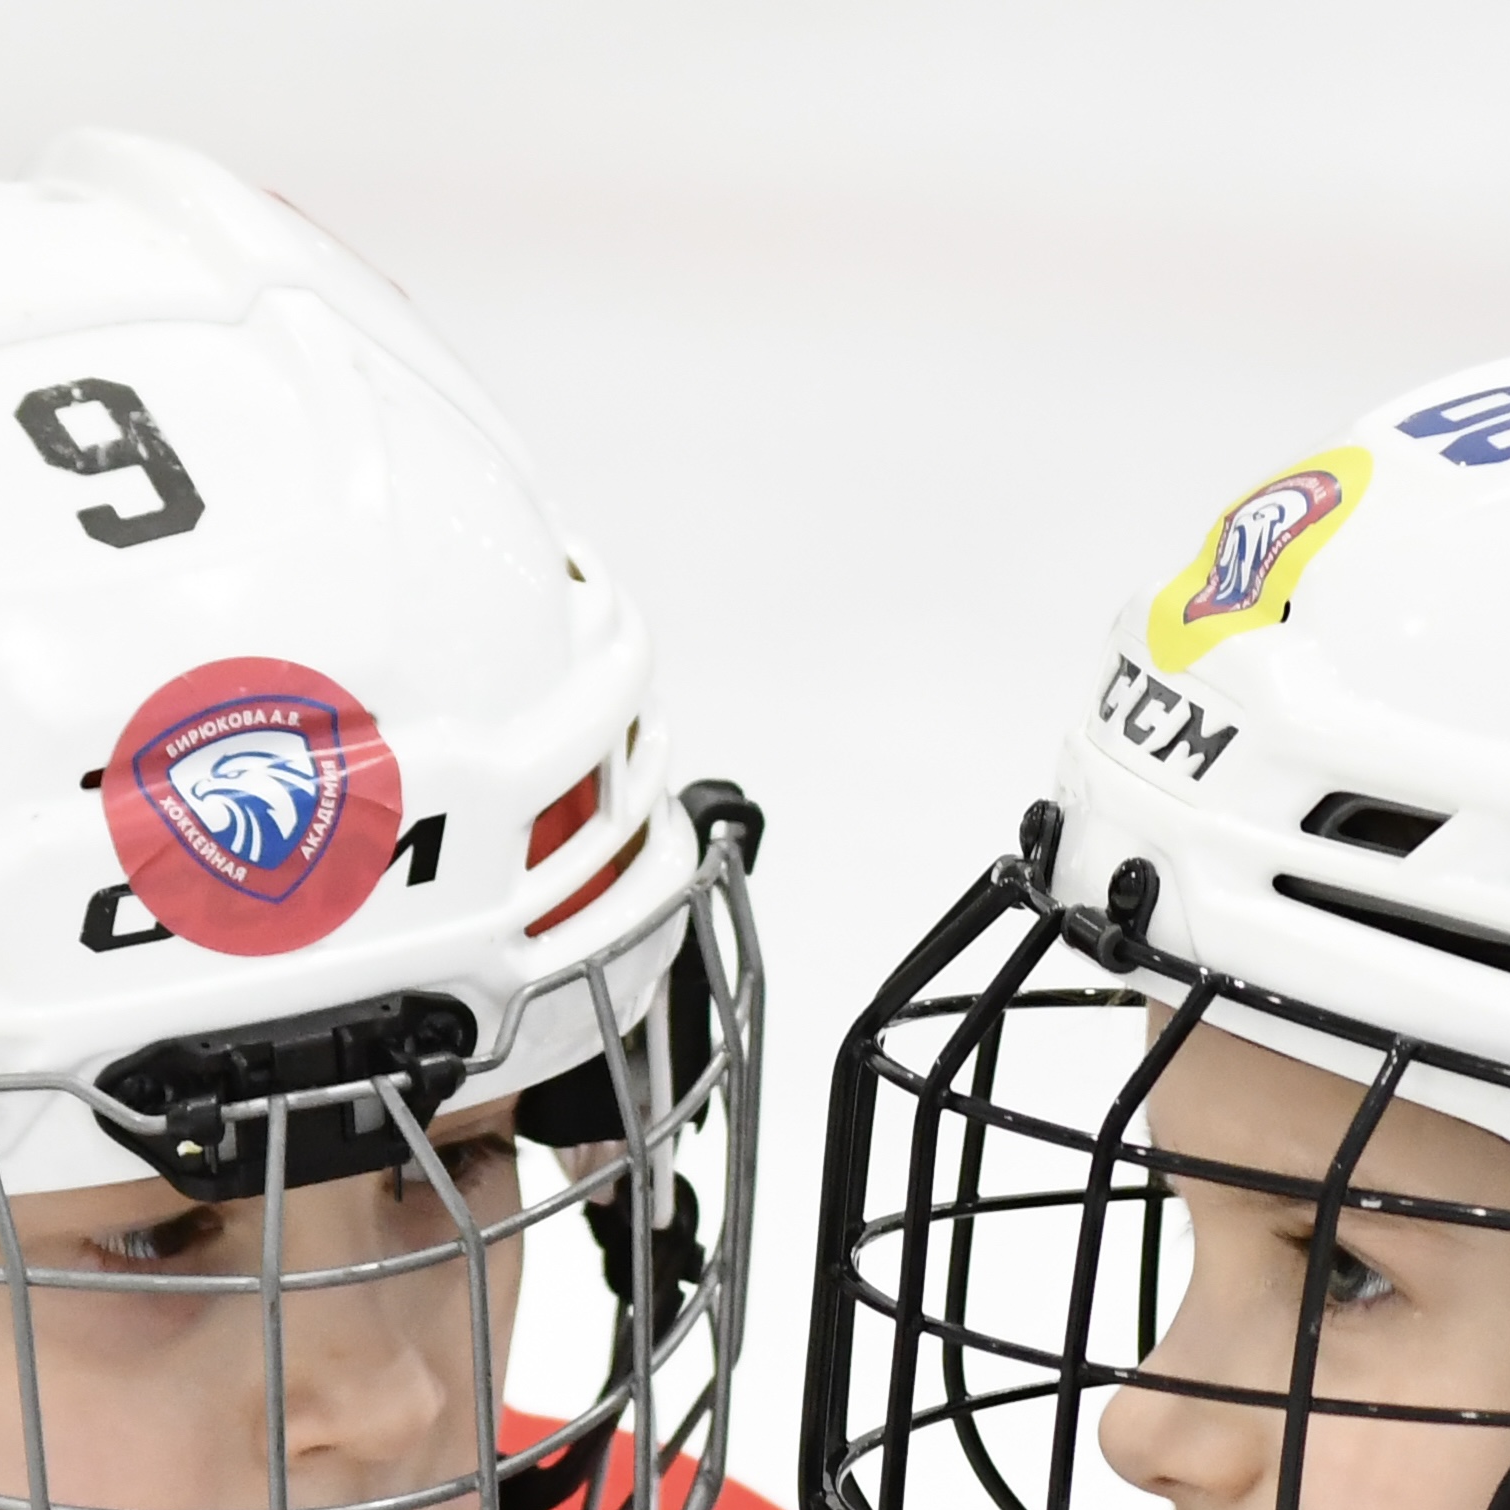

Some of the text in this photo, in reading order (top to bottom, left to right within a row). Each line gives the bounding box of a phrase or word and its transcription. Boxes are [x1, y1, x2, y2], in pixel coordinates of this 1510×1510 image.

[13, 376, 207, 550] 9
[165, 708, 268, 759] БИРЮКОВА
[1098, 653, 1240, 783] CCM
[158, 795, 248, 883] ХОККЕЙНАЯ
[300, 760, 340, 862] АКАДЕМИЯ
